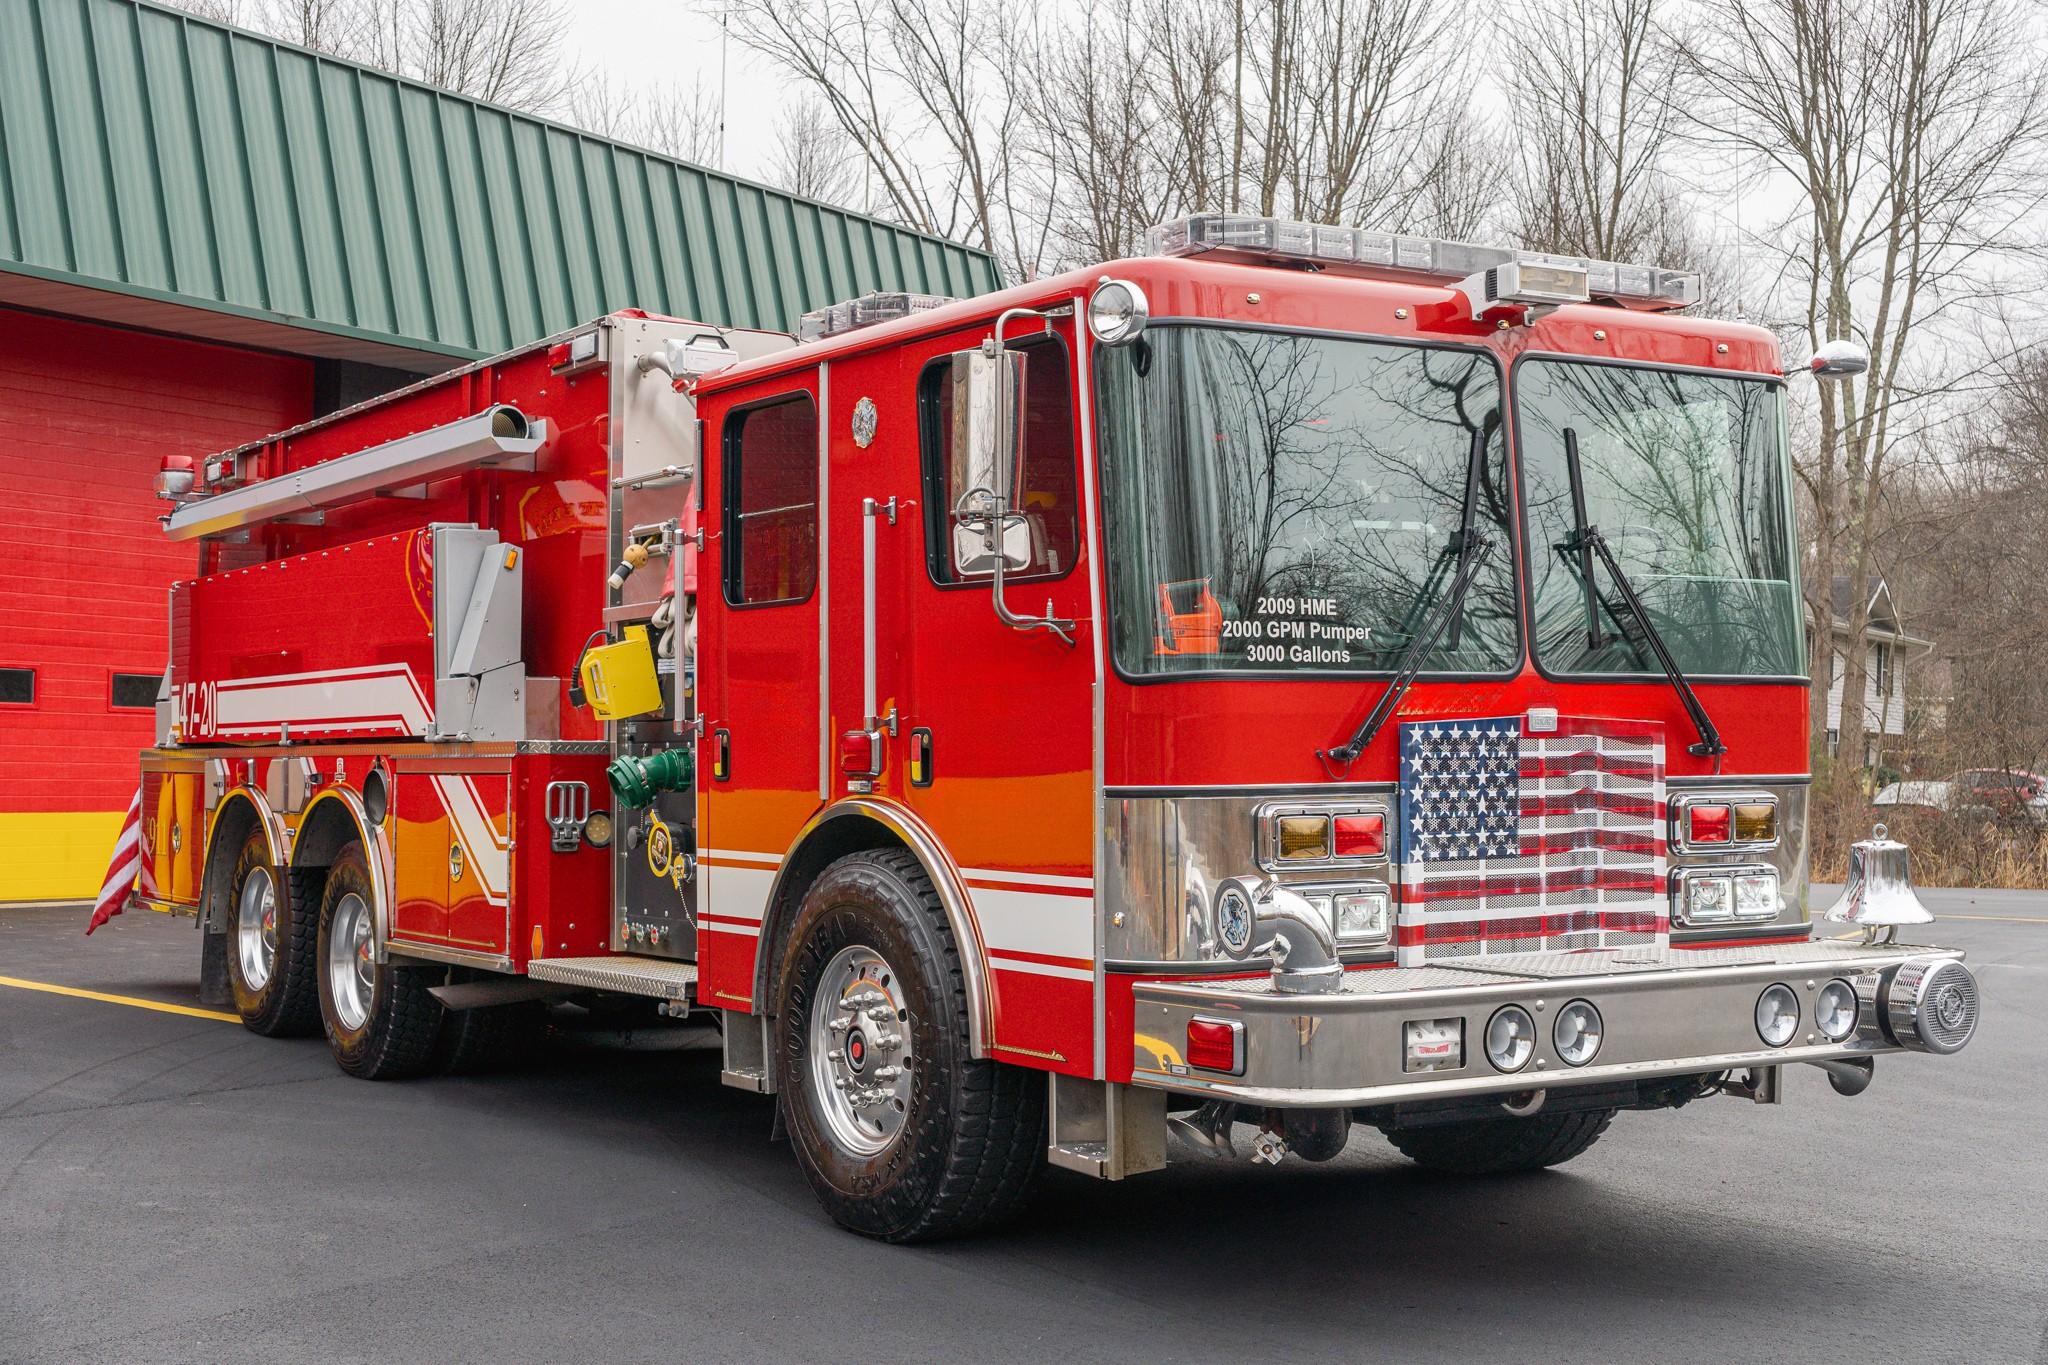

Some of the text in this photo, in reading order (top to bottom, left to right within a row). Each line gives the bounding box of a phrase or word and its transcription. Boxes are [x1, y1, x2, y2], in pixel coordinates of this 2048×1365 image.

[1257, 597, 1337, 616] 2009 HME
[1222, 621, 1371, 643] 2000 GPM Pumper
[1246, 645, 1351, 663] 3000 Gallons
[179, 681, 217, 737] 47-20
